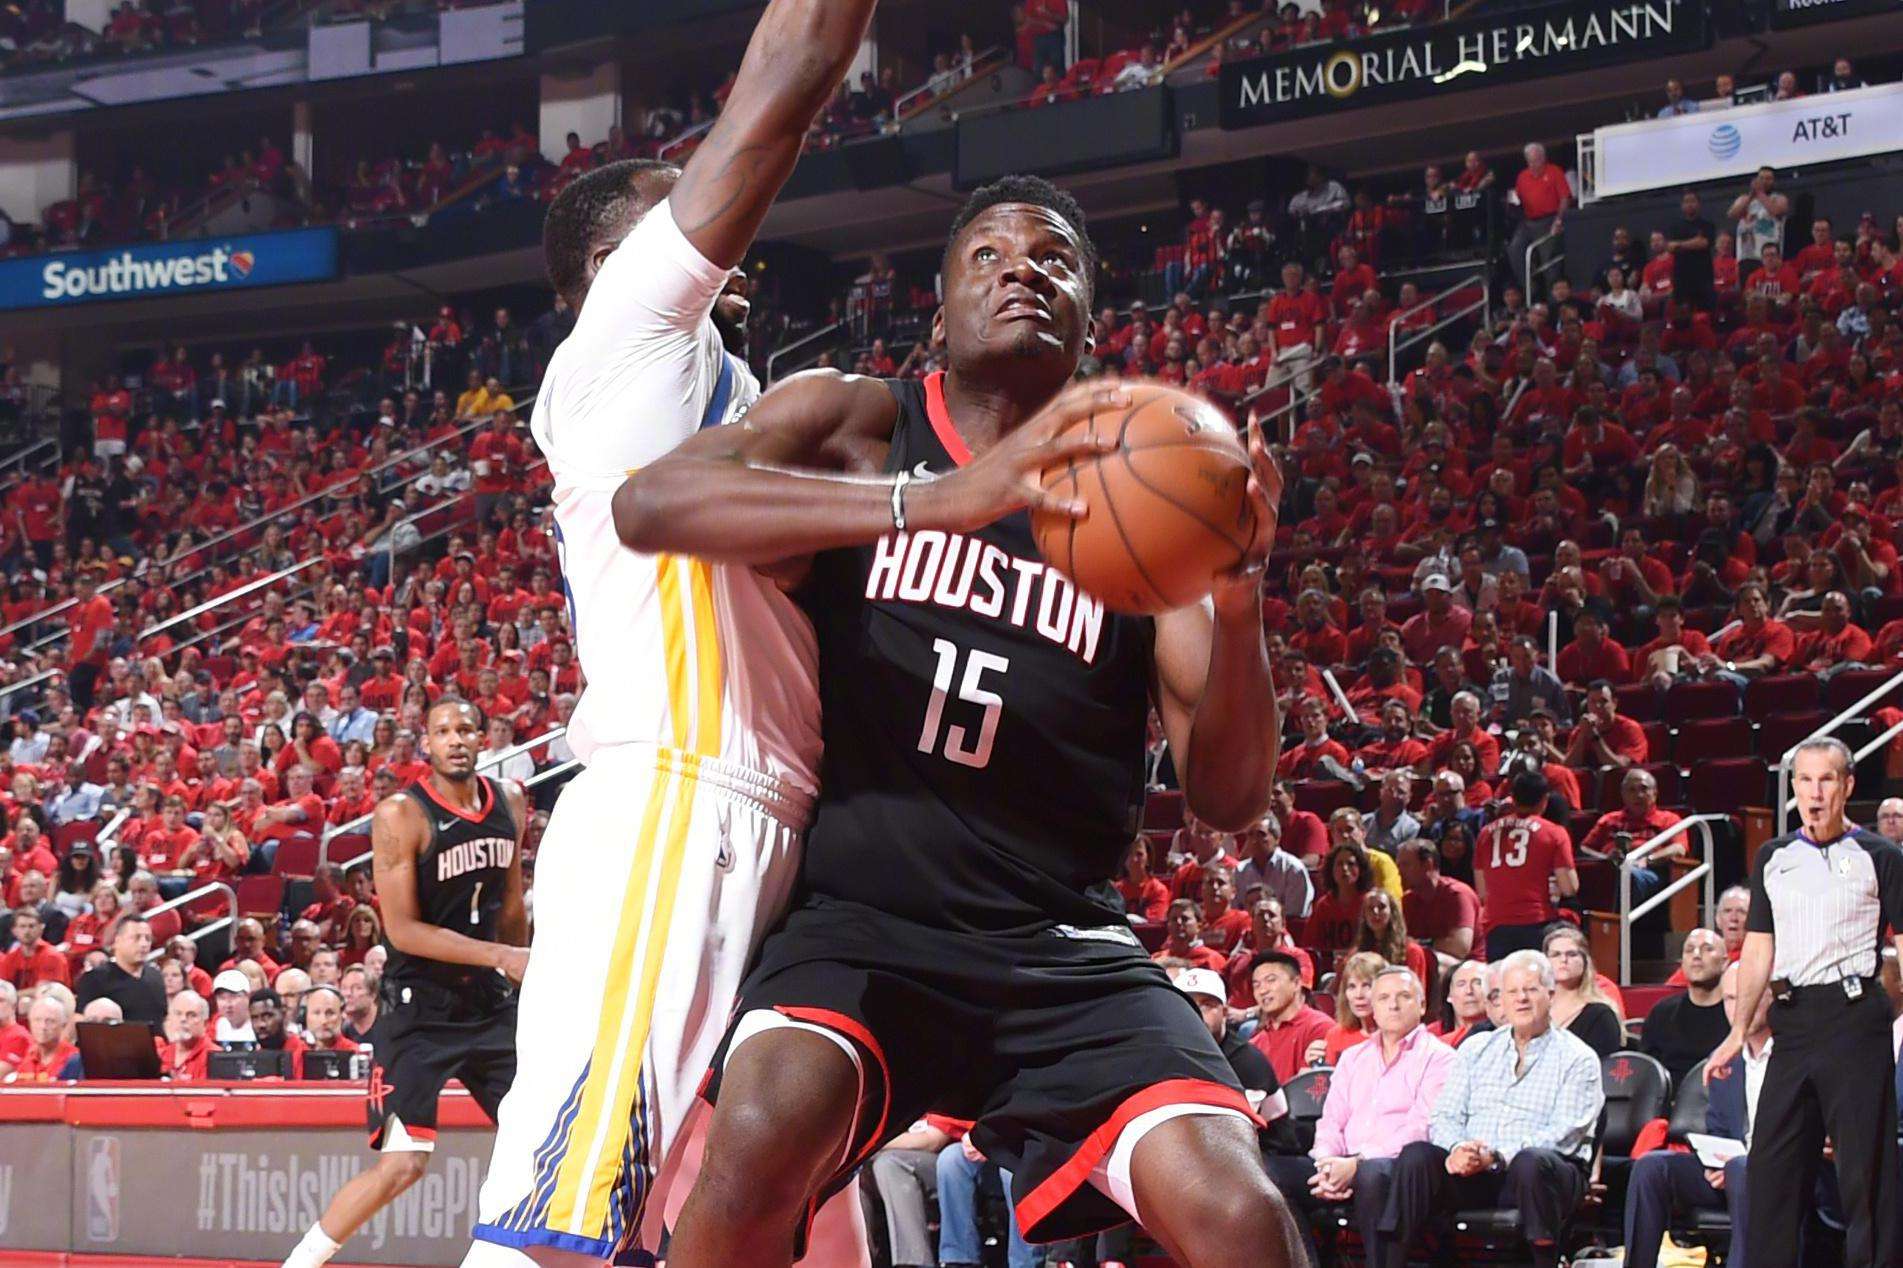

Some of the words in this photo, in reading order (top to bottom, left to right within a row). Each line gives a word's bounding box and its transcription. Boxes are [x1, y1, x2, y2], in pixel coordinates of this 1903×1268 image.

[1239, 41, 1441, 108] MEMORIAL
[1458, 0, 1672, 64] HERMANN
[1792, 113, 1852, 143] AT&T
[43, 248, 228, 299] Southwest
[865, 530, 1104, 665] HOUSTON
[917, 637, 1010, 769] 15
[1490, 828, 1530, 868] 13
[470, 882, 483, 924] 1
